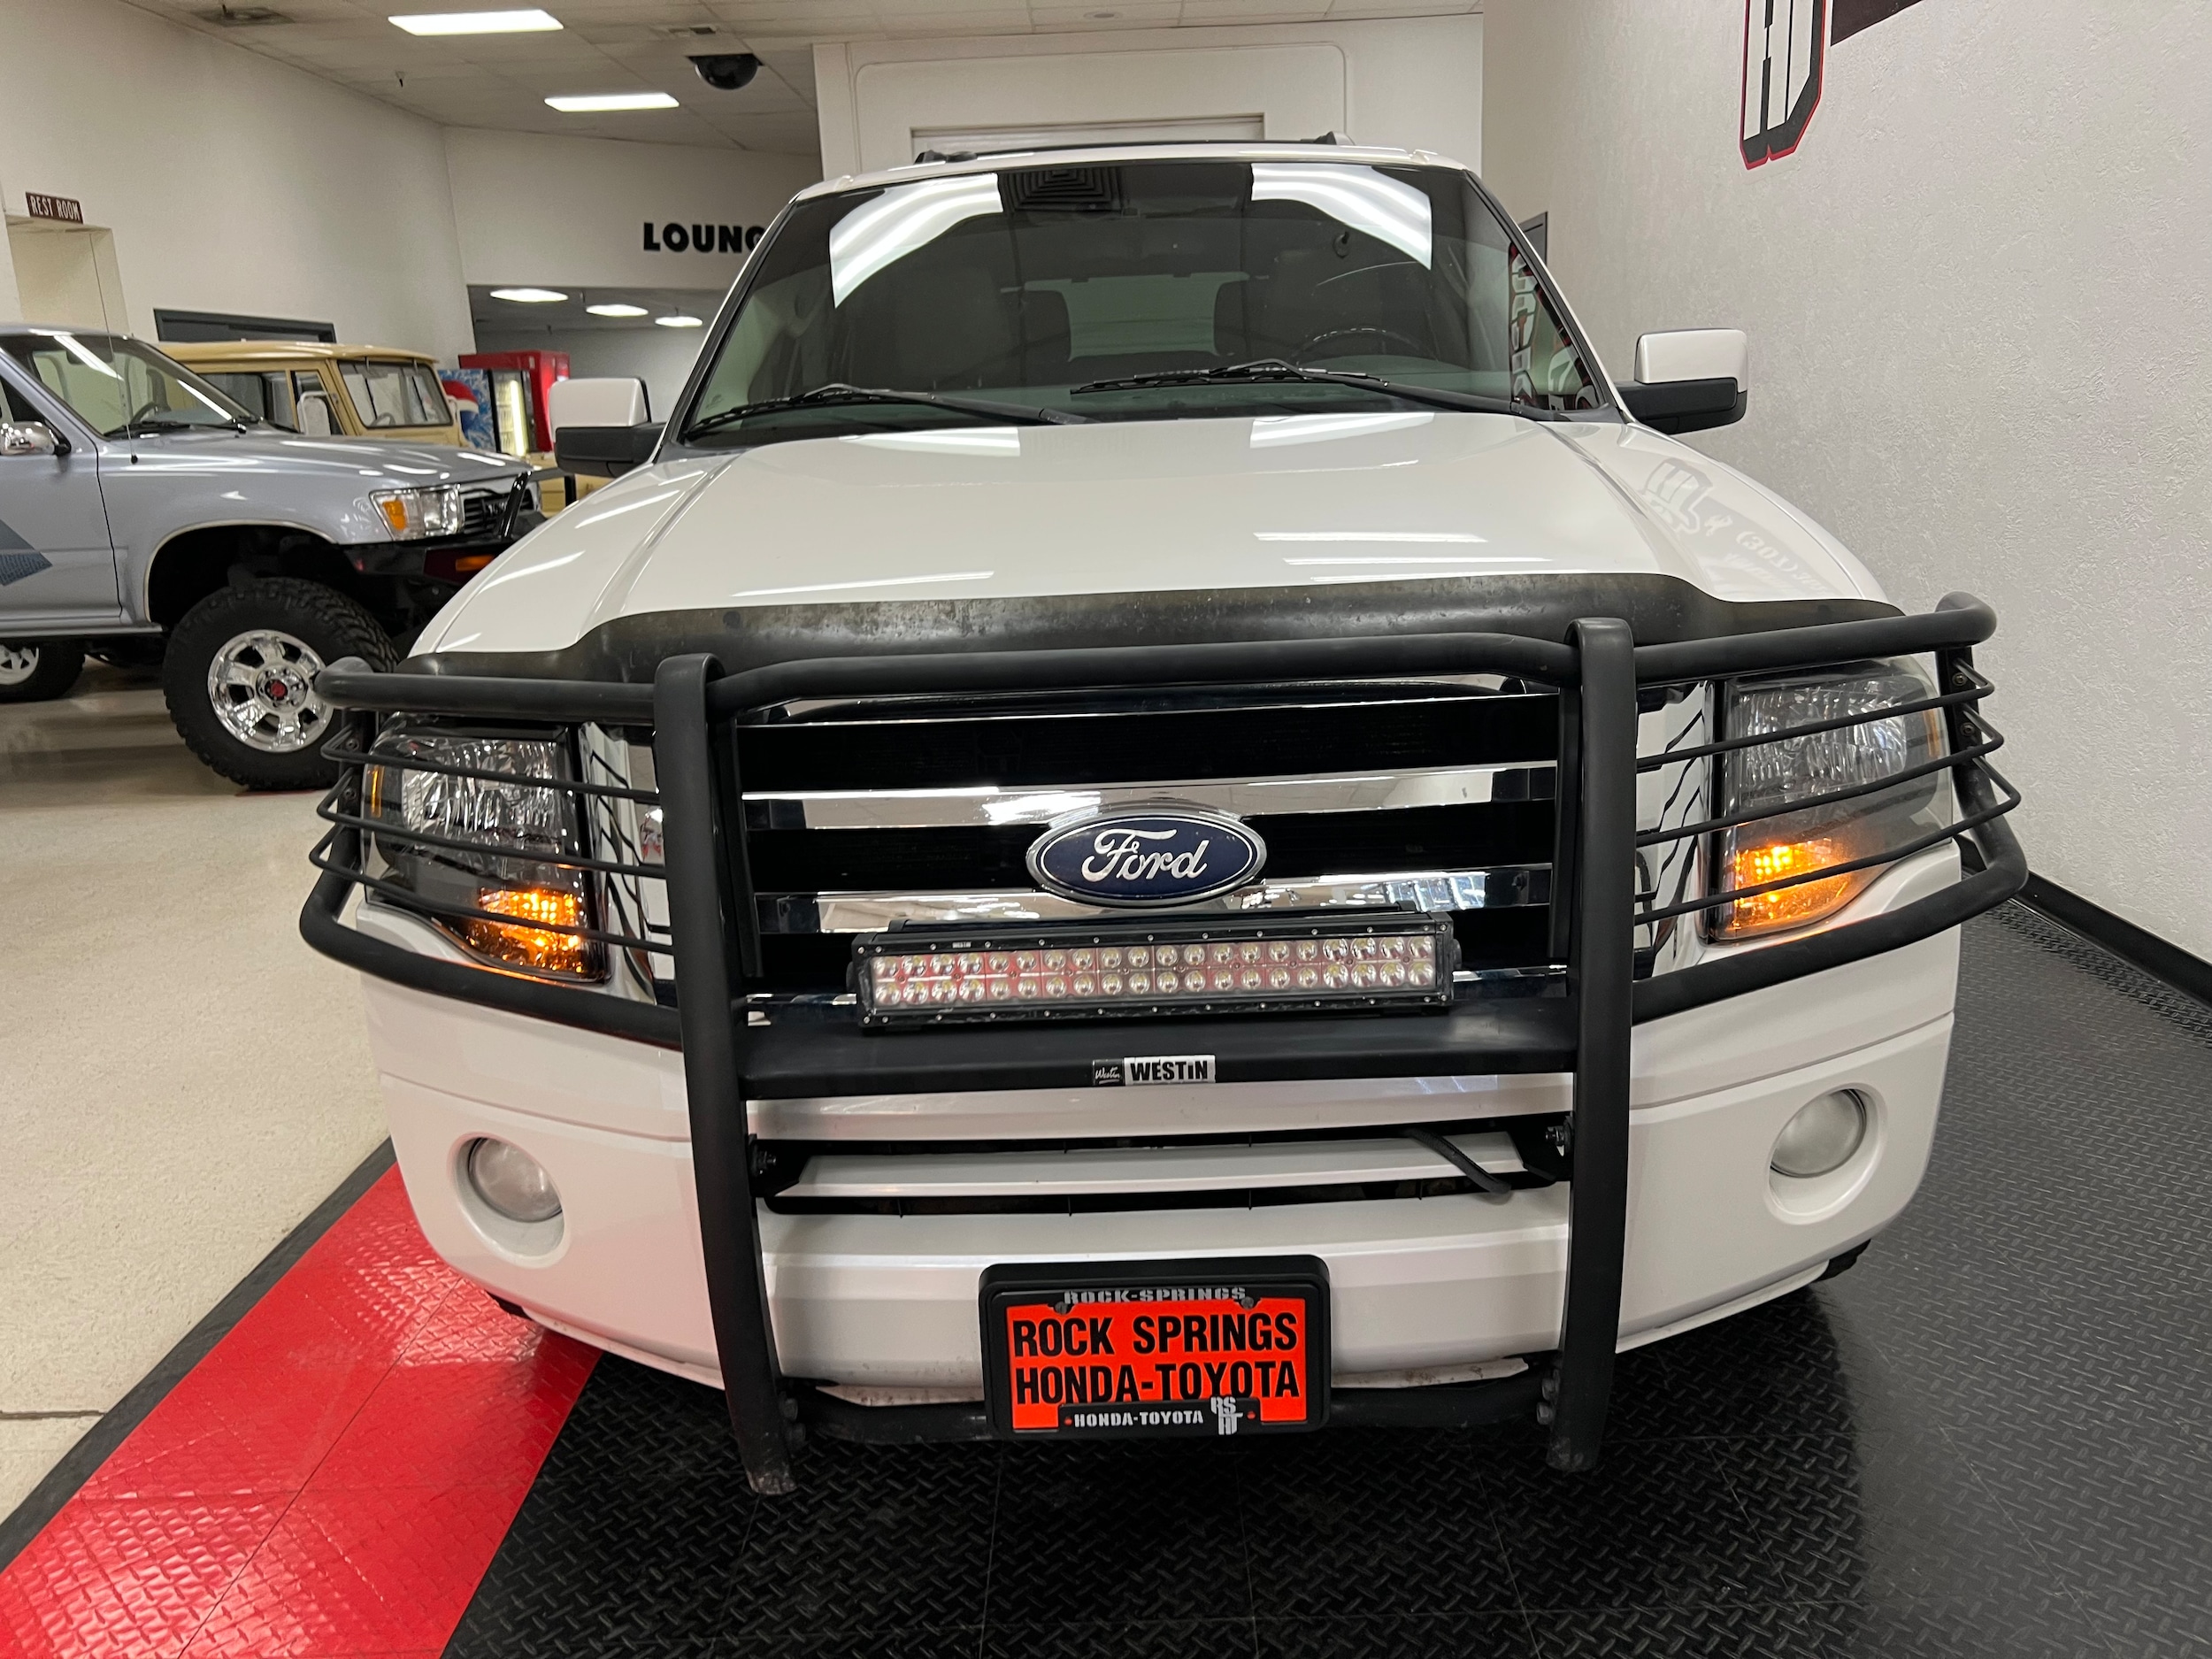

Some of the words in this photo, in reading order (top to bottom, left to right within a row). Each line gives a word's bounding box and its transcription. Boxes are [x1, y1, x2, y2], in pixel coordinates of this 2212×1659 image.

[29, 195, 53, 217] REST
[55, 198, 81, 221] ROOM
[1080, 827, 1211, 883] Ford
[1012, 1316, 1116, 1357] ROCK
[1132, 1311, 1299, 1355] SPRINGS
[1015, 1360, 1301, 1405] HONDA-TOYOTA
[1073, 1409, 1204, 1428] HONDA-TOYOTA
